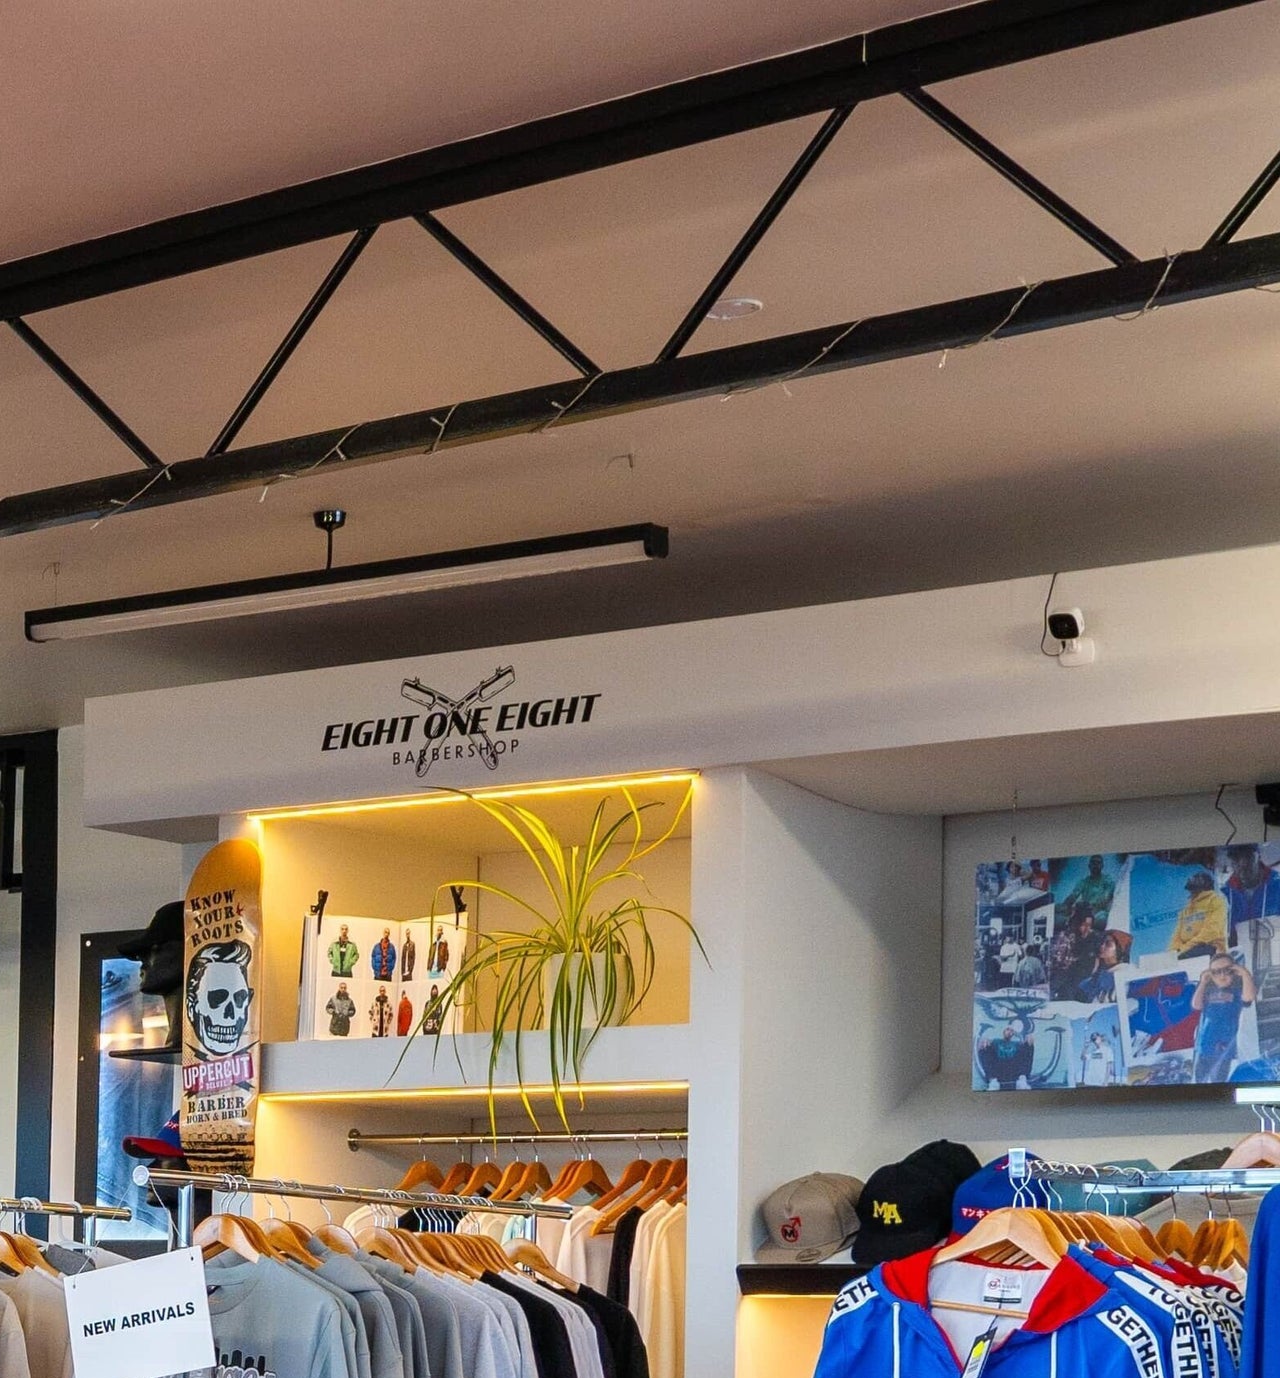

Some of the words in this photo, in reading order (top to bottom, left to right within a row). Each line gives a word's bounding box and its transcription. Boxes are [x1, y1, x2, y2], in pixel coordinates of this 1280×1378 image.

[321, 714, 420, 752] EIGHT
[423, 706, 493, 741] ONE
[495, 693, 602, 731] EIGHT
[392, 738, 520, 766] BARBERSHOP
[190, 888, 236, 912] KNOW
[193, 905, 236, 929] YOUR
[190, 919, 244, 948] ROOTS
[183, 1055, 251, 1090] UPPERCUT
[186, 1113, 211, 1124] BORN
[211, 1112, 220, 1122] &
[221, 1109, 248, 1121] BRED
[187, 1096, 246, 1115] BARBER
[872, 1200, 902, 1224] MA
[961, 1207, 991, 1219] マンキ
[82, 1317, 117, 1338] NEW
[121, 1301, 195, 1329] ARRIVALS
